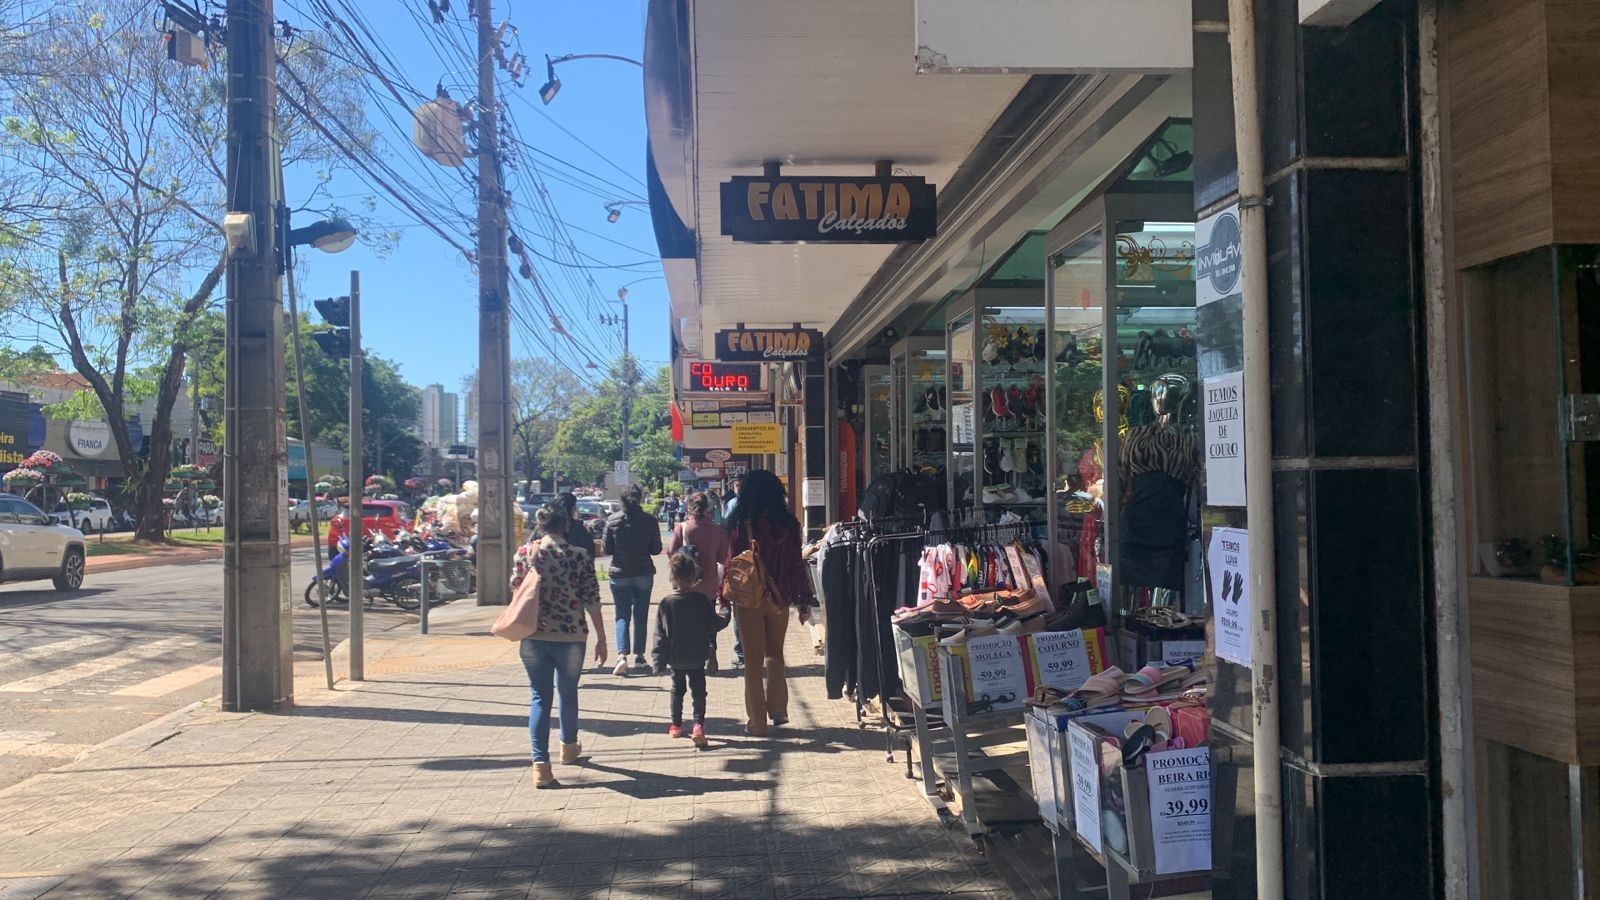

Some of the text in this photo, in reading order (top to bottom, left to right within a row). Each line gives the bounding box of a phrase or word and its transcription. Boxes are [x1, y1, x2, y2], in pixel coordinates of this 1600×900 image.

[747, 182, 911, 220] FATIMA
[818, 210, 908, 234] Calçados
[1198, 241, 1240, 271] INVIOLÁV
[728, 332, 811, 352] FATIMA
[763, 345, 808, 358] Calçados
[702, 375, 747, 387] OURO
[1208, 385, 1238, 403] TEMOS
[1208, 407, 1239, 422] JAQUITA
[1218, 425, 1228, 437] DE
[1210, 442, 1238, 457] COURO
[1221, 540, 1240, 552] TEMOS
[1038, 639, 1080, 653] COTURNO
[975, 651, 1012, 662] MOLECA
[928, 641, 941, 694] moleca
[1047, 659, 1073, 671] 59,99
[980, 669, 1007, 680] 59,99
[1152, 752, 1209, 769] PROMOÇÃ
[1158, 772, 1194, 783] BEIRA
[1166, 798, 1208, 816] 39,99
